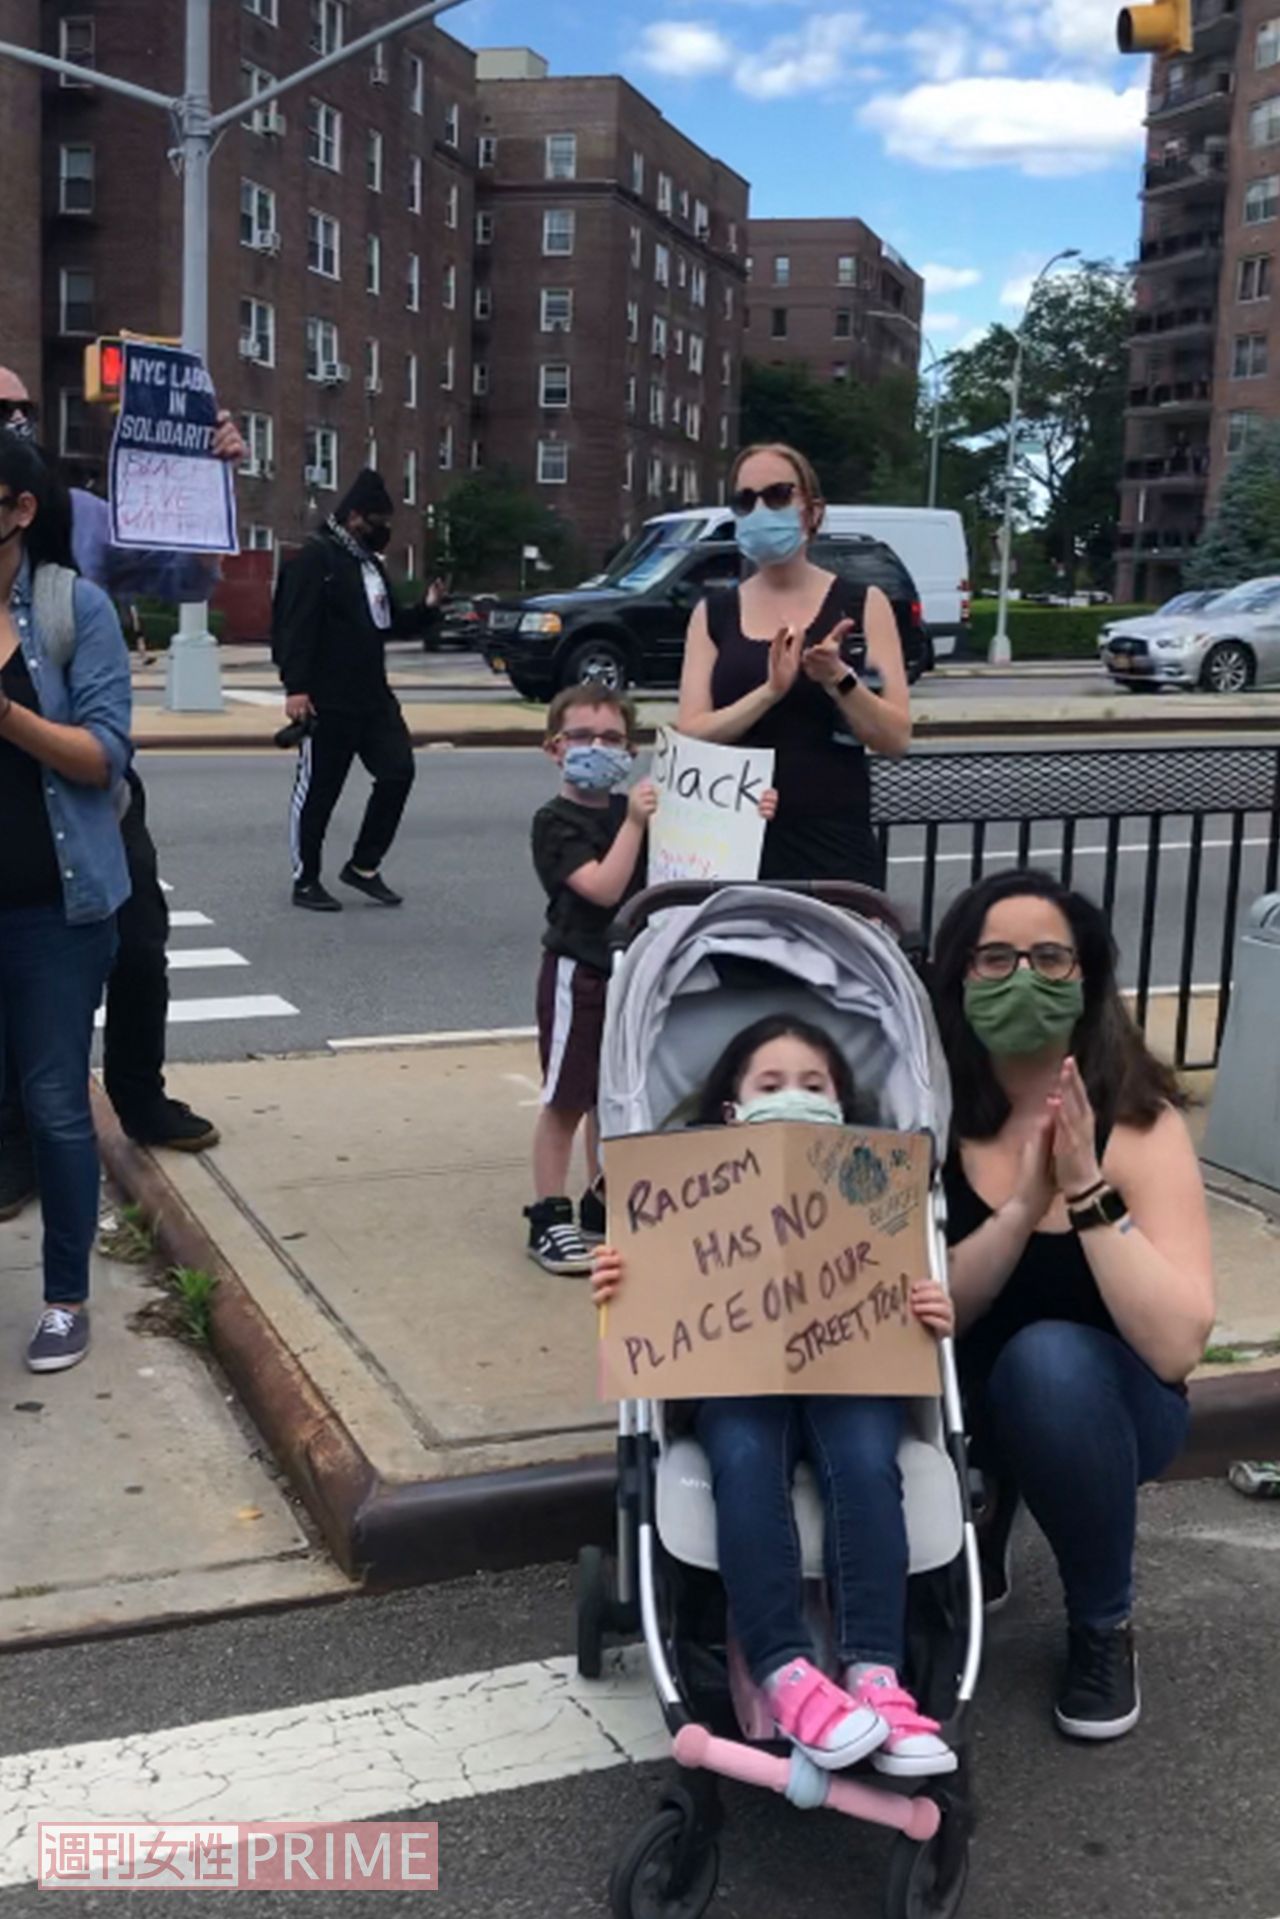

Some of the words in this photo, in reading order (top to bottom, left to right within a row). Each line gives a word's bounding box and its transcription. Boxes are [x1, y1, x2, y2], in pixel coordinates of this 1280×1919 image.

[130, 358, 166, 384] NYC
[169, 391, 187, 416] IN
[121, 415, 216, 450] SOLIDARIT
[627, 1148, 762, 1233] RACISM
[693, 1225, 762, 1275] HAS
[771, 1190, 828, 1246] NO
[624, 1290, 753, 1375] PLACE
[762, 1270, 808, 1321] ON
[818, 1240, 880, 1300] OUR
[785, 1299, 870, 1374] STREET
